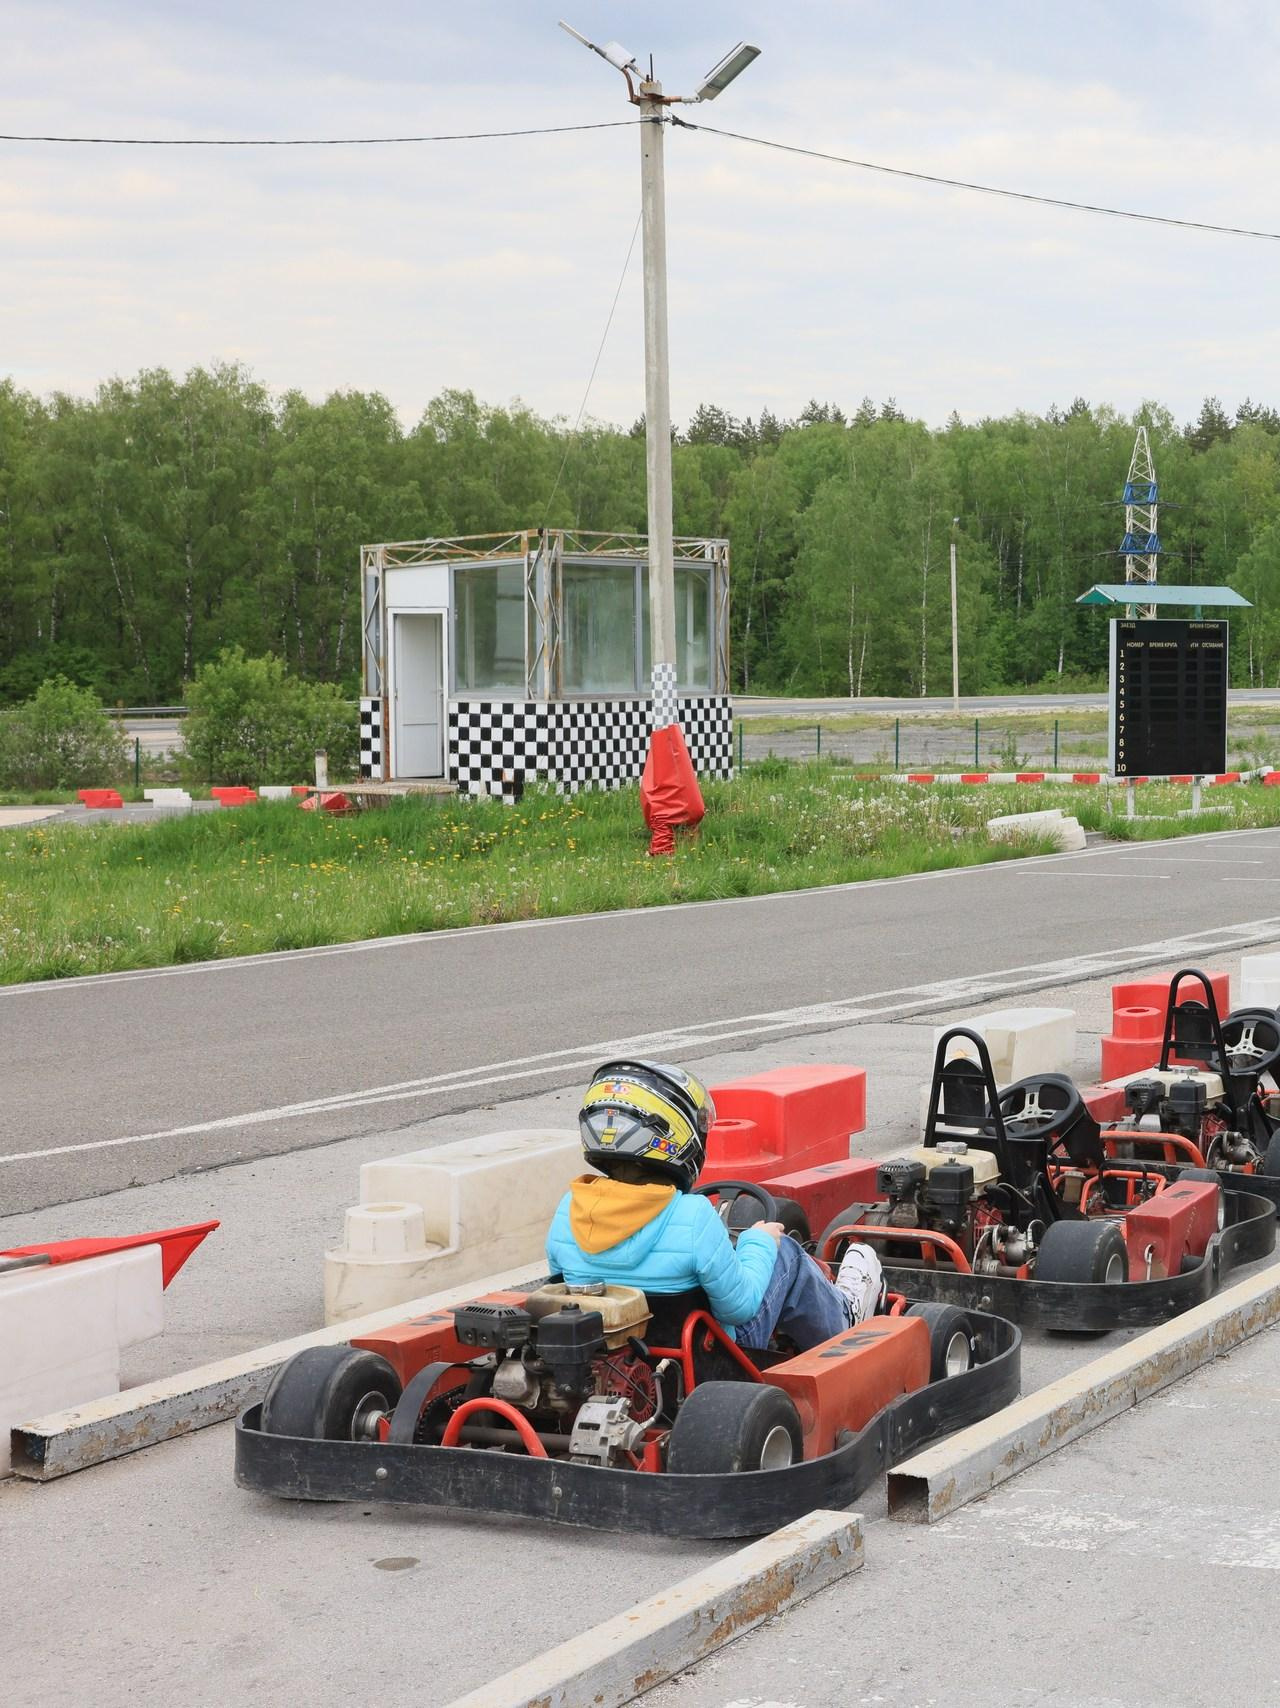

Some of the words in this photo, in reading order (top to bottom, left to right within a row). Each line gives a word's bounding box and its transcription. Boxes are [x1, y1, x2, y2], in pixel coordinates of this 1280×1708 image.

[1120, 650, 1124, 658] 1
[1120, 662, 1124, 670] 2
[1120, 675, 1124, 683] 3
[1120, 688, 1124, 696] 4
[1120, 700, 1124, 708] 5
[1120, 713, 1124, 721] 6
[1120, 726, 1124, 734] 7
[1119, 738, 1124, 746] 8
[1119, 752, 1124, 760] 9
[1118, 764, 1126, 772] 10
[651, 1137, 679, 1155] BOXS
